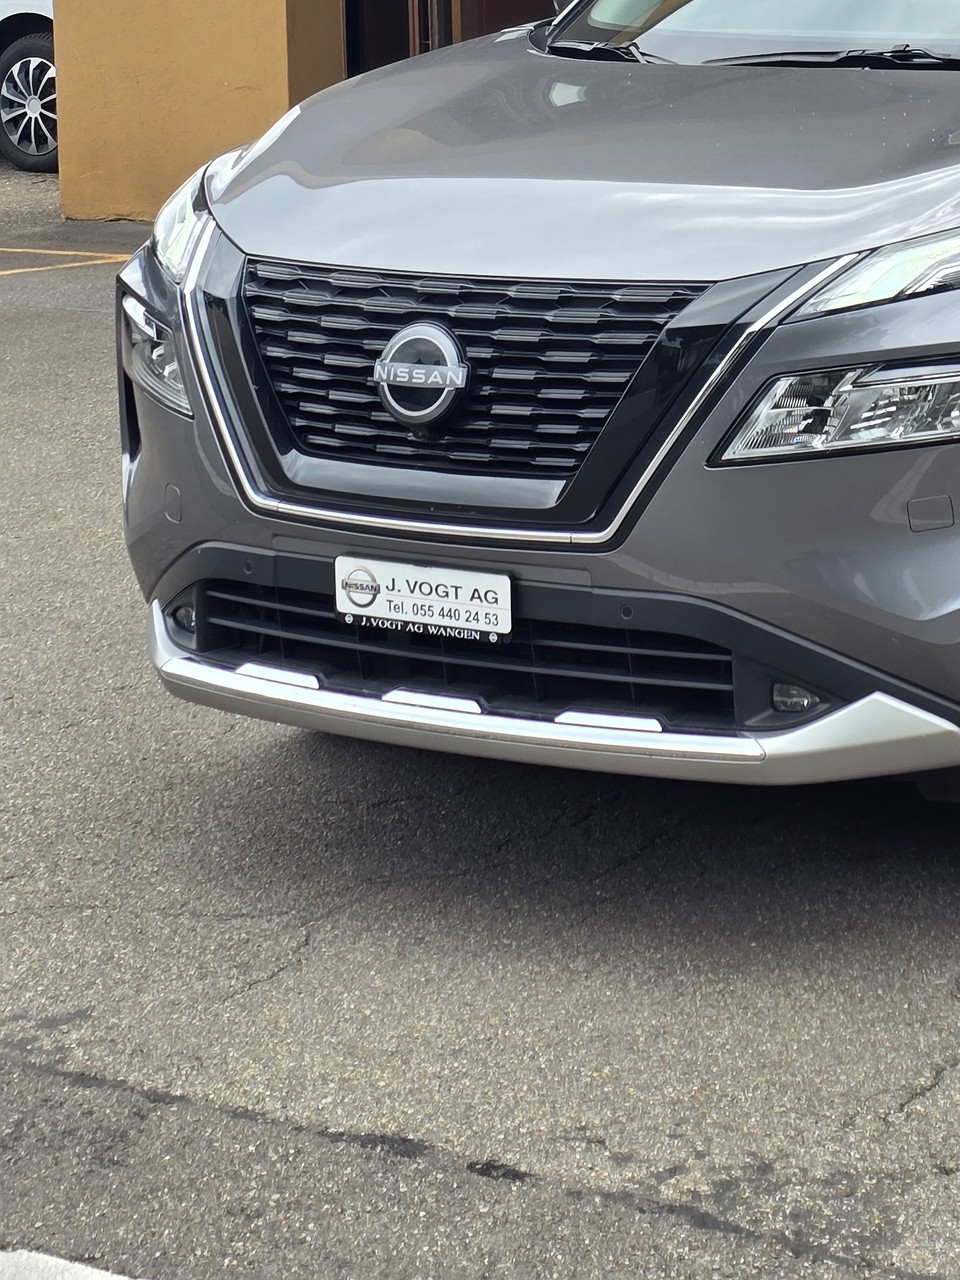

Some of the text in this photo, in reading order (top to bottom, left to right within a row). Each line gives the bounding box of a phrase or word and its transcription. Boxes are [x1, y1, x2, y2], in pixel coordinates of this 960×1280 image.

[374, 365, 463, 385] NISSAN
[345, 581, 377, 593] NISSAN
[386, 578, 499, 605] J. VOGT AG
[386, 599, 499, 627] Tel. 055 440 24 53
[406, 623, 424, 633] AG
[427, 625, 480, 640] WANGEN
